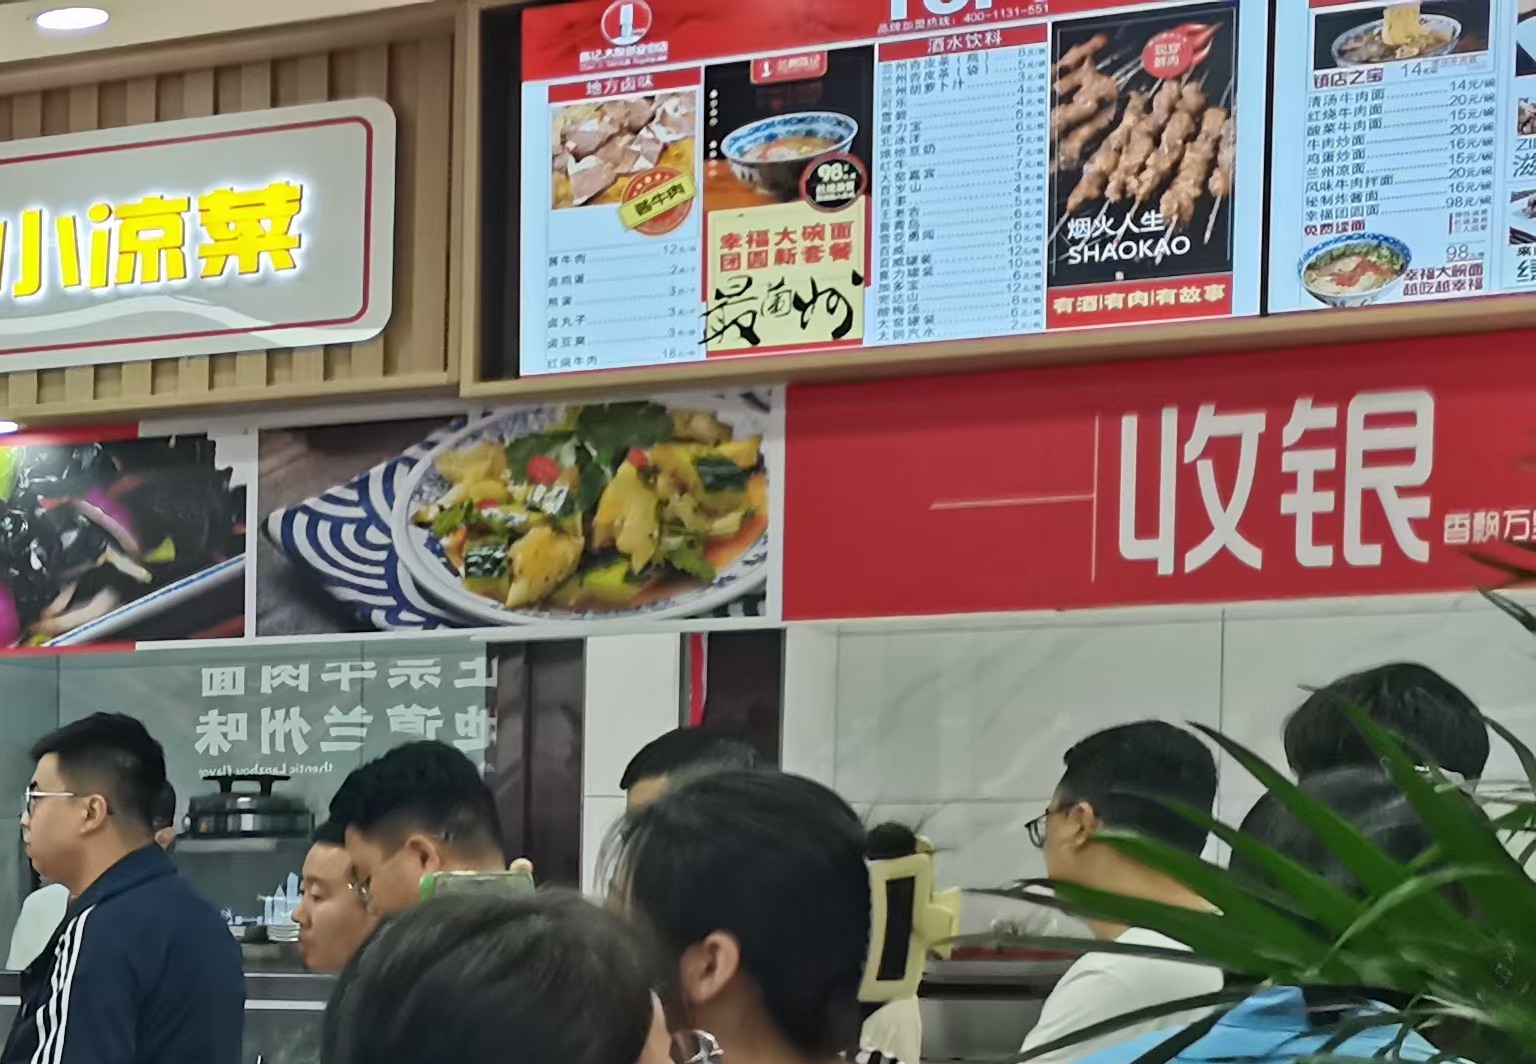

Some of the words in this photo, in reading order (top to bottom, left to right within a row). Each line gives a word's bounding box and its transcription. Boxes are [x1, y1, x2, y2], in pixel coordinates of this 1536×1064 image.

[928, 29, 1002, 53] 酒水饮料
[585, 74, 654, 95] 地方卤味
[1313, 67, 1384, 89] 镇店之宝
[1308, 88, 1384, 107] 清汤牛肉面
[1308, 103, 1383, 122] 红烧牛肉面
[1307, 117, 1382, 136] 酸菜牛肉面
[1307, 134, 1365, 150] 牛肉炒面
[1306, 148, 1365, 165] 鸡蛋炒面
[1306, 163, 1365, 178] 兰州凉面
[1305, 174, 1394, 193] 风味牛肉拌面
[1305, 191, 1378, 208] 秘制炸酱面
[1305, 204, 1379, 222] 幸福团圆面
[1066, 210, 1166, 240] 烟火人生
[1304, 219, 1366, 236] 免费续面
[719, 221, 855, 251] 幸福大碗面
[719, 243, 854, 272] 团圆新套餐
[1068, 236, 1191, 266] SHAOKAO
[1119, 390, 1434, 577] 收银
[1444, 509, 1536, 544] 香飘万
